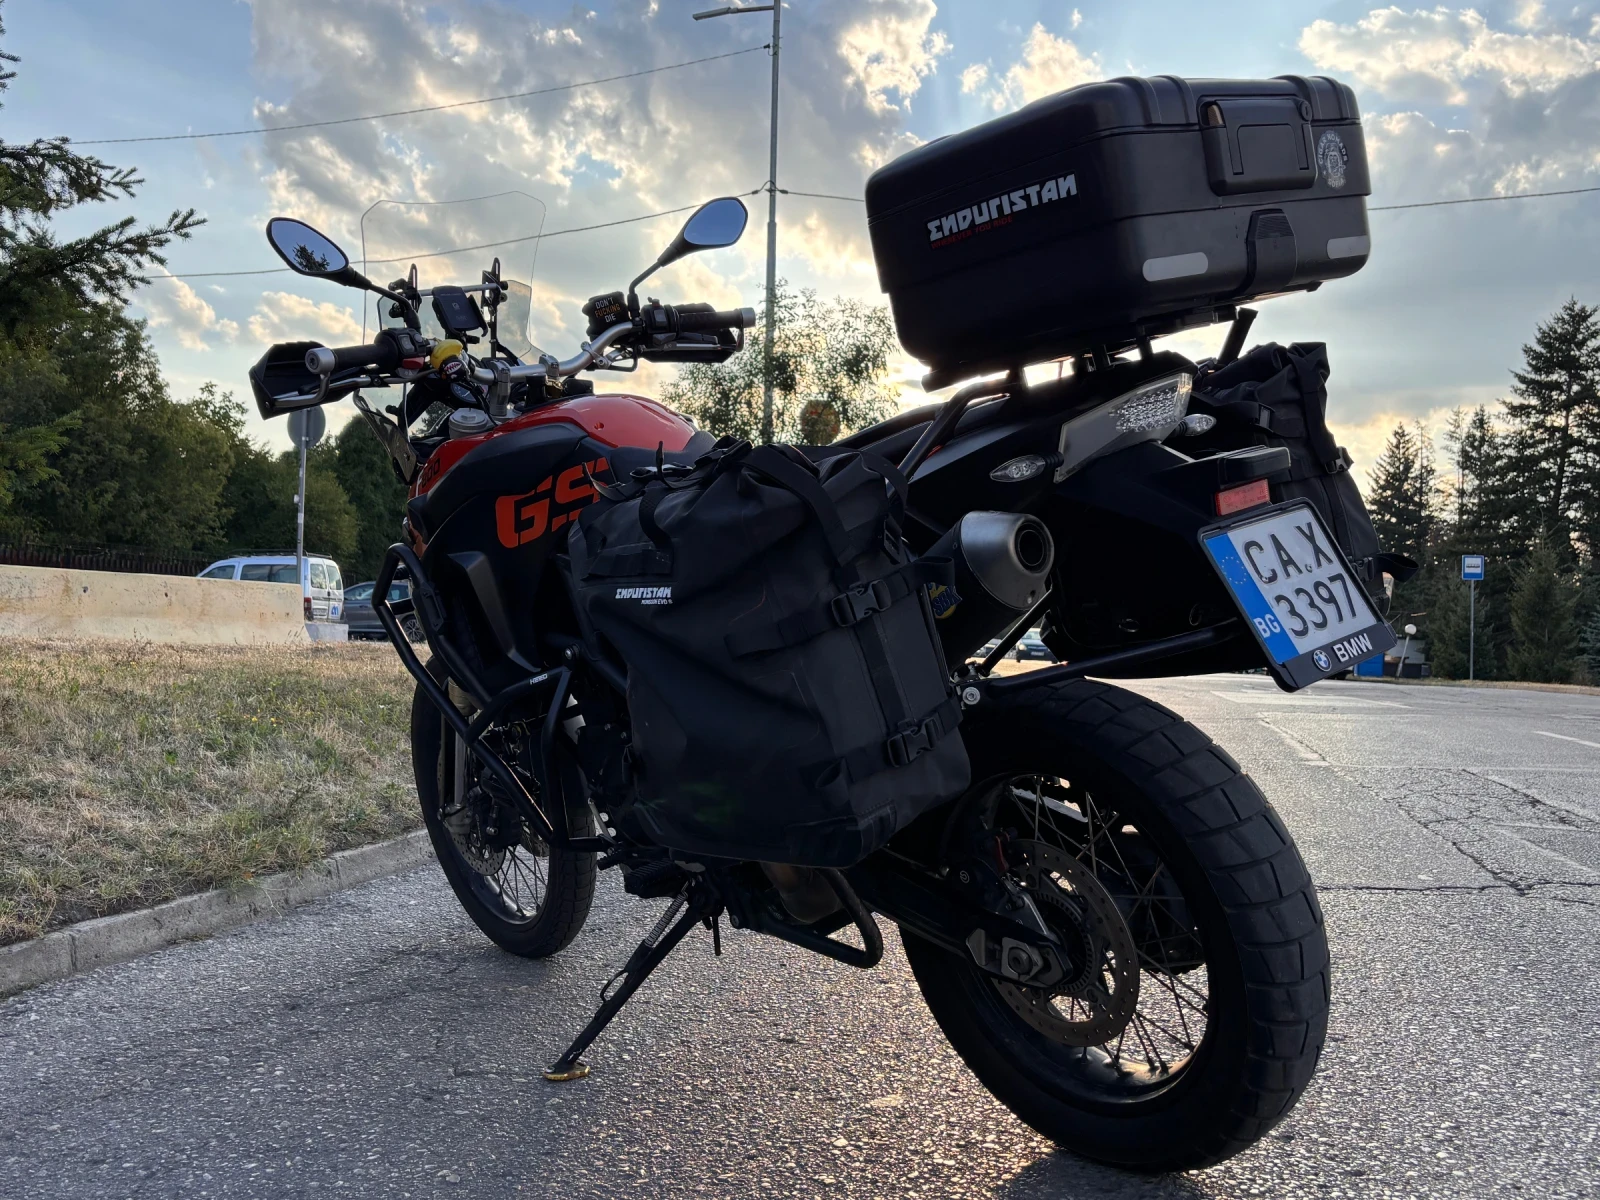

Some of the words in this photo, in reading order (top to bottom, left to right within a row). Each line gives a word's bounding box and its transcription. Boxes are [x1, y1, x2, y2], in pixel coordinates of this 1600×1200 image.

[927, 173, 1078, 242] ENDURISTAN
[931, 231, 973, 250] WHEREVER
[974, 222, 992, 234] YOU
[992, 215, 1013, 228] RIDE
[594, 303, 621, 318] FUCKING
[595, 297, 614, 309] DON'T
[604, 313, 617, 323] DIE
[495, 457, 609, 549] GS
[615, 586, 672, 599] ENDURISTAN
[1274, 572, 1358, 638] 3397
[1252, 613, 1281, 639] BG
[1333, 633, 1373, 662] BMW
